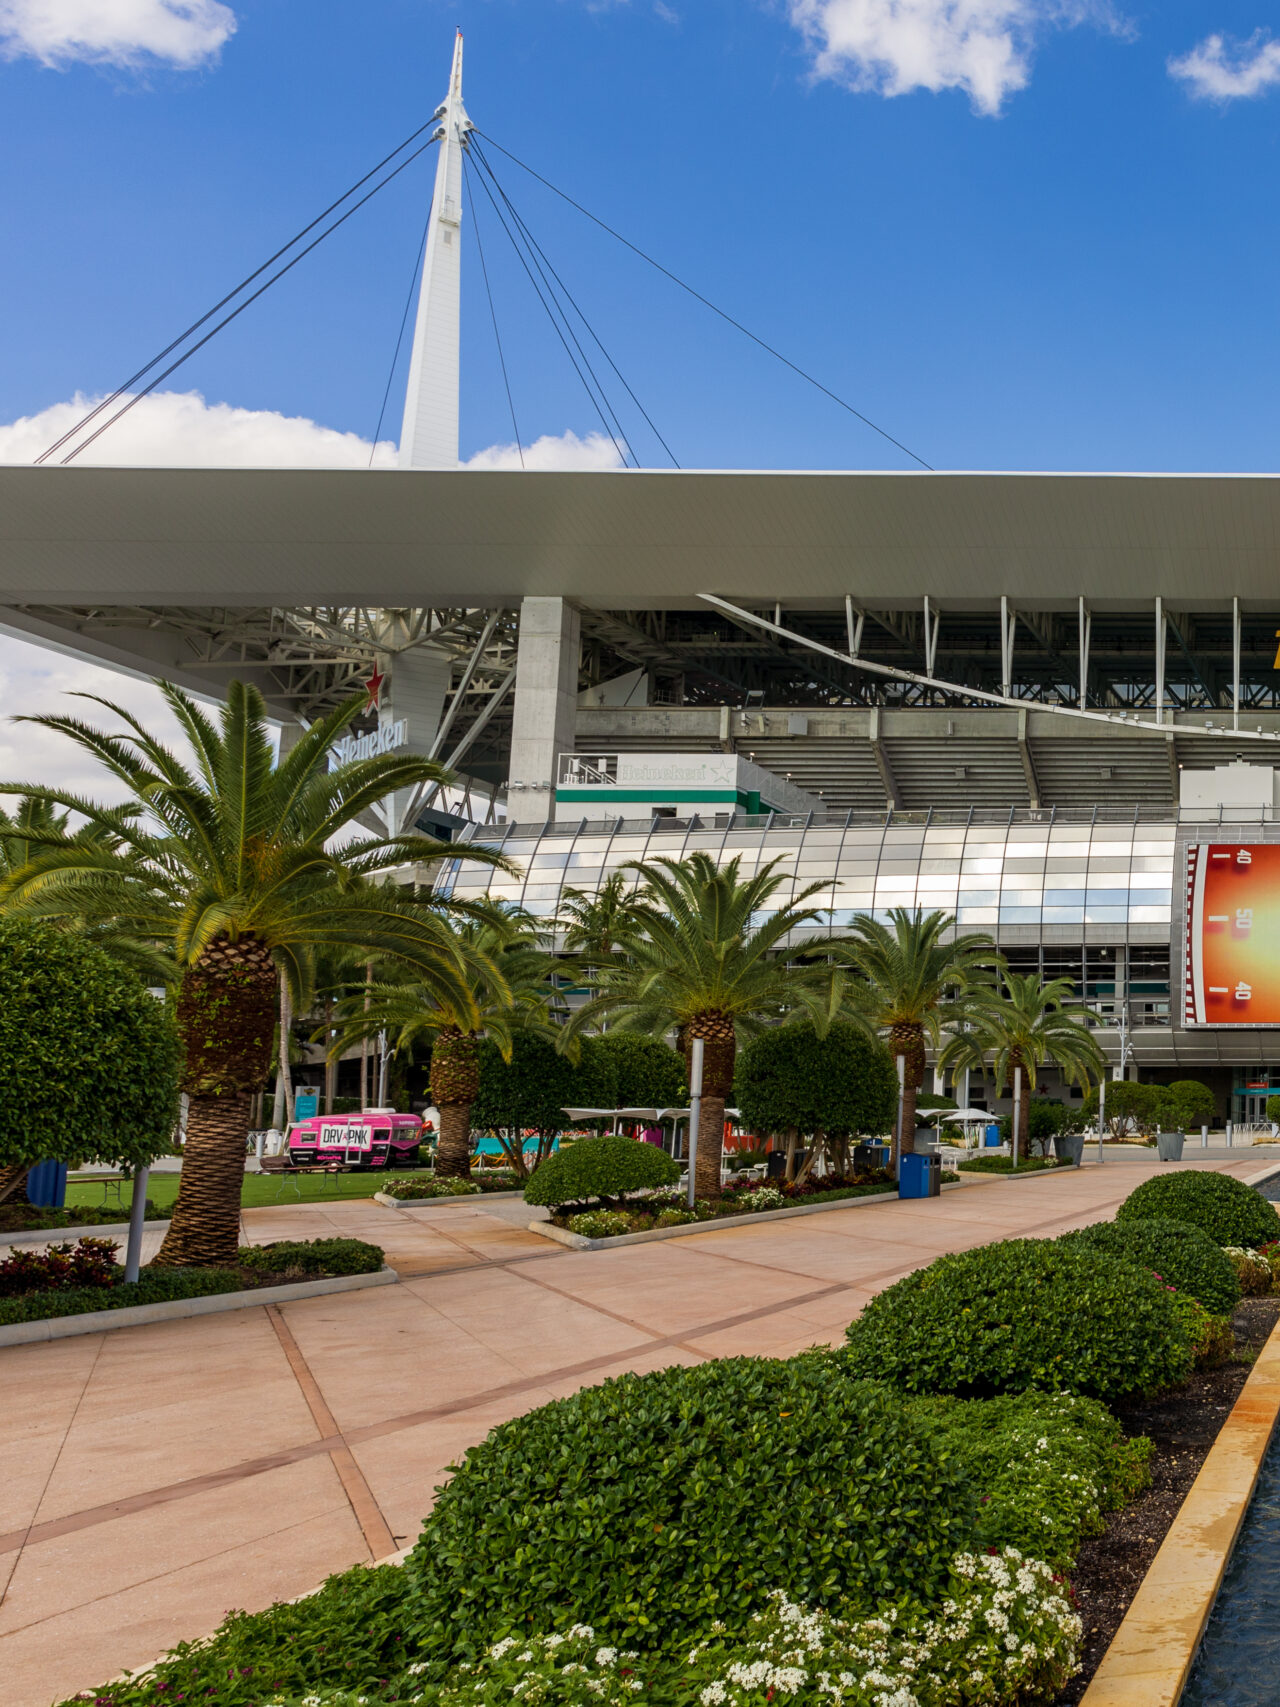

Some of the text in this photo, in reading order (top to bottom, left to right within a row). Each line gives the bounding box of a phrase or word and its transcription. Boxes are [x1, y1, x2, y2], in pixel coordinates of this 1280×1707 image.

[340, 718, 408, 765] Heineken
[622, 764, 706, 780] Heineken
[1237, 849, 1252, 864] 40
[1236, 908, 1253, 929] 50
[1235, 981, 1252, 1000] 40
[323, 1128, 368, 1145] DRV PNK
